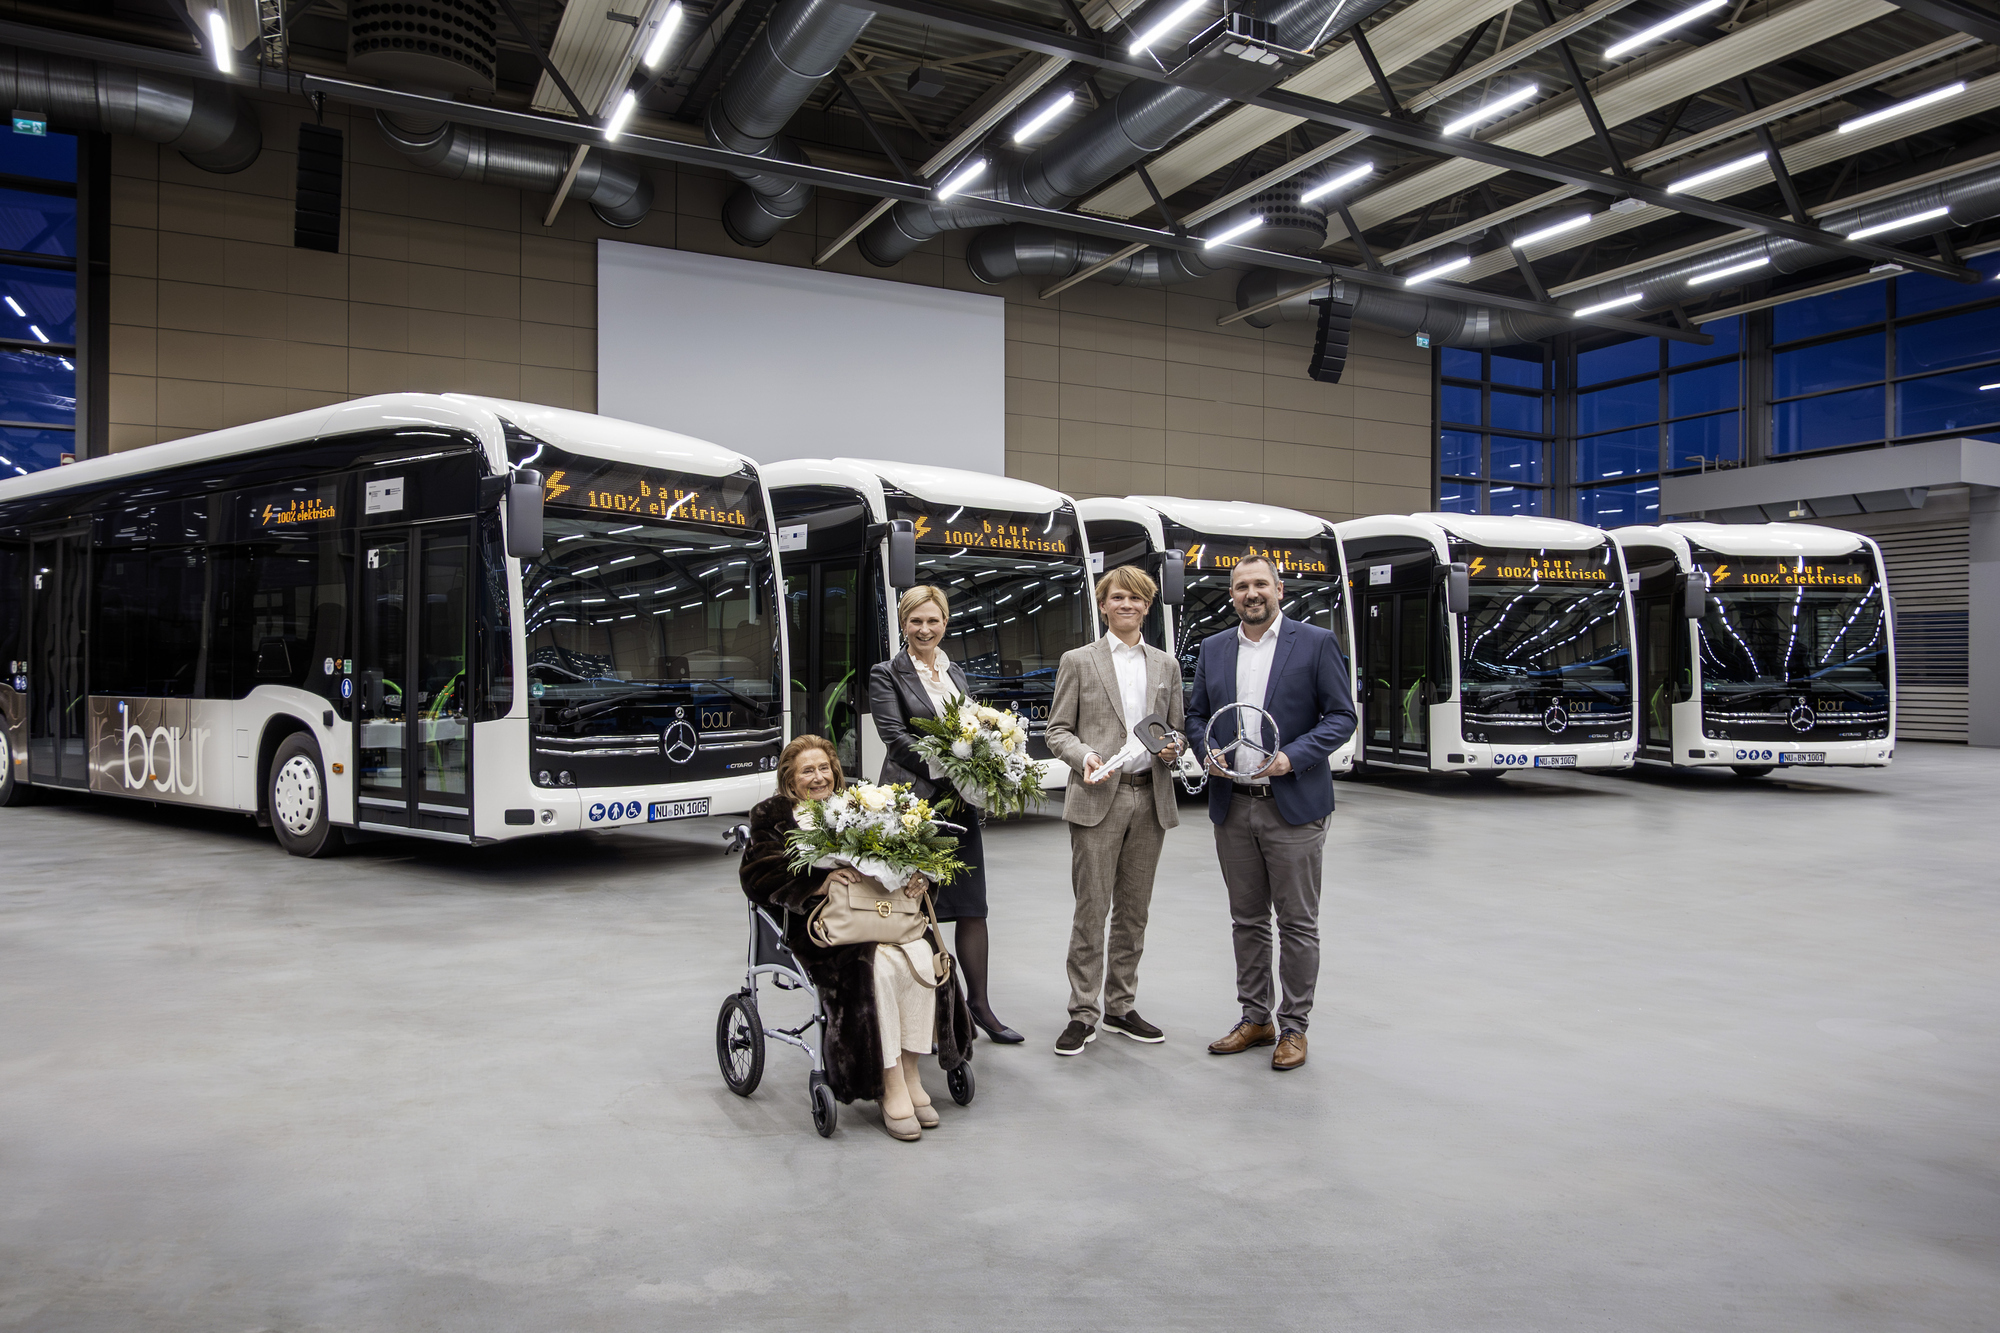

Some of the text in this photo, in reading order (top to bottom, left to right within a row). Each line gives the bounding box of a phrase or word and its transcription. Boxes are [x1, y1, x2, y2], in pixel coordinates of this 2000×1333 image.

[641, 480, 700, 503] baur
[291, 499, 322, 511] baur
[588, 490, 641, 513] 100%
[277, 505, 336, 524] 100% elektrisch
[983, 520, 1030, 537] baur
[945, 530, 1066, 553] 100% elektrisch
[1214, 555, 1244, 568] 100
[1530, 557, 1572, 569] baur
[1779, 563, 1825, 575] baur
[1497, 566, 1606, 580] 100% elektrisch
[1742, 573, 1863, 585] 100% elektrisch
[701, 707, 733, 729] baur
[1030, 701, 1050, 720] ba
[123, 704, 211, 797] baur
[1784, 754, 1794, 762] NU
[1540, 757, 1548, 766] NU
[655, 801, 707, 819] NU BN 1005
